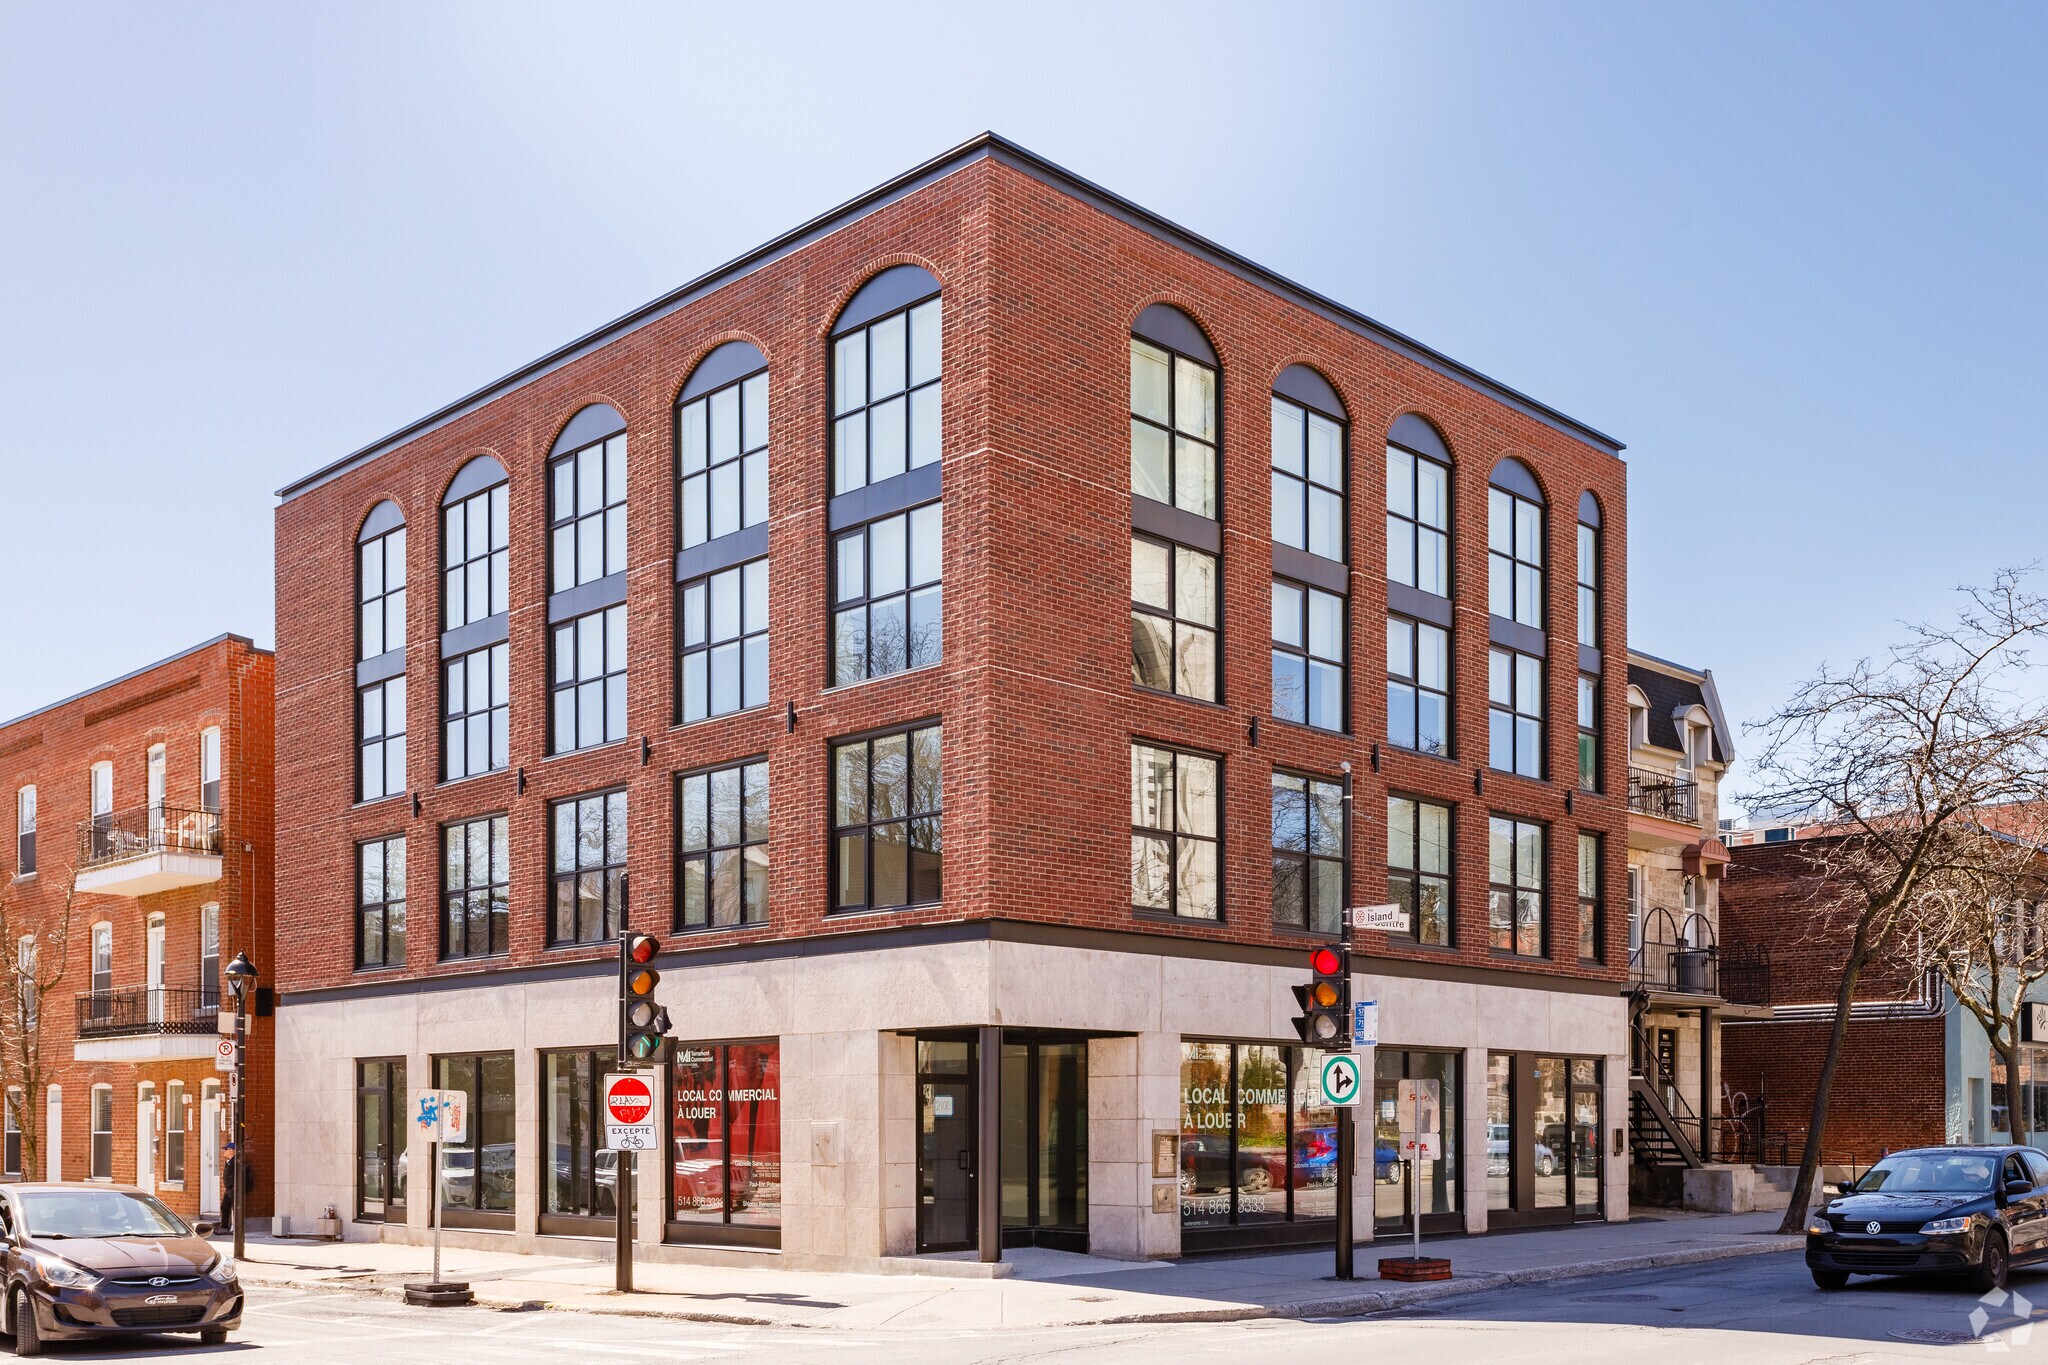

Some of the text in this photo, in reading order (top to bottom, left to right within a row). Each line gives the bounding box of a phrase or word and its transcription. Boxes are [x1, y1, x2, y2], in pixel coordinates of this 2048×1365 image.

[1367, 911, 1393, 922] Island
[1358, 1019, 1364, 1027] 71
[677, 1048, 691, 1063] NAI
[677, 1089, 707, 1102] LOCAL
[1184, 1088, 1229, 1105] LOCAL
[677, 1105, 716, 1119] À LOUER
[1184, 1109, 1246, 1129] À LOUER
[612, 1127, 650, 1135] EXCEPTÉ
[677, 1196, 690, 1206] 514
[692, 1196, 705, 1207] 866
[1183, 1197, 1265, 1216] 514 866 3333
